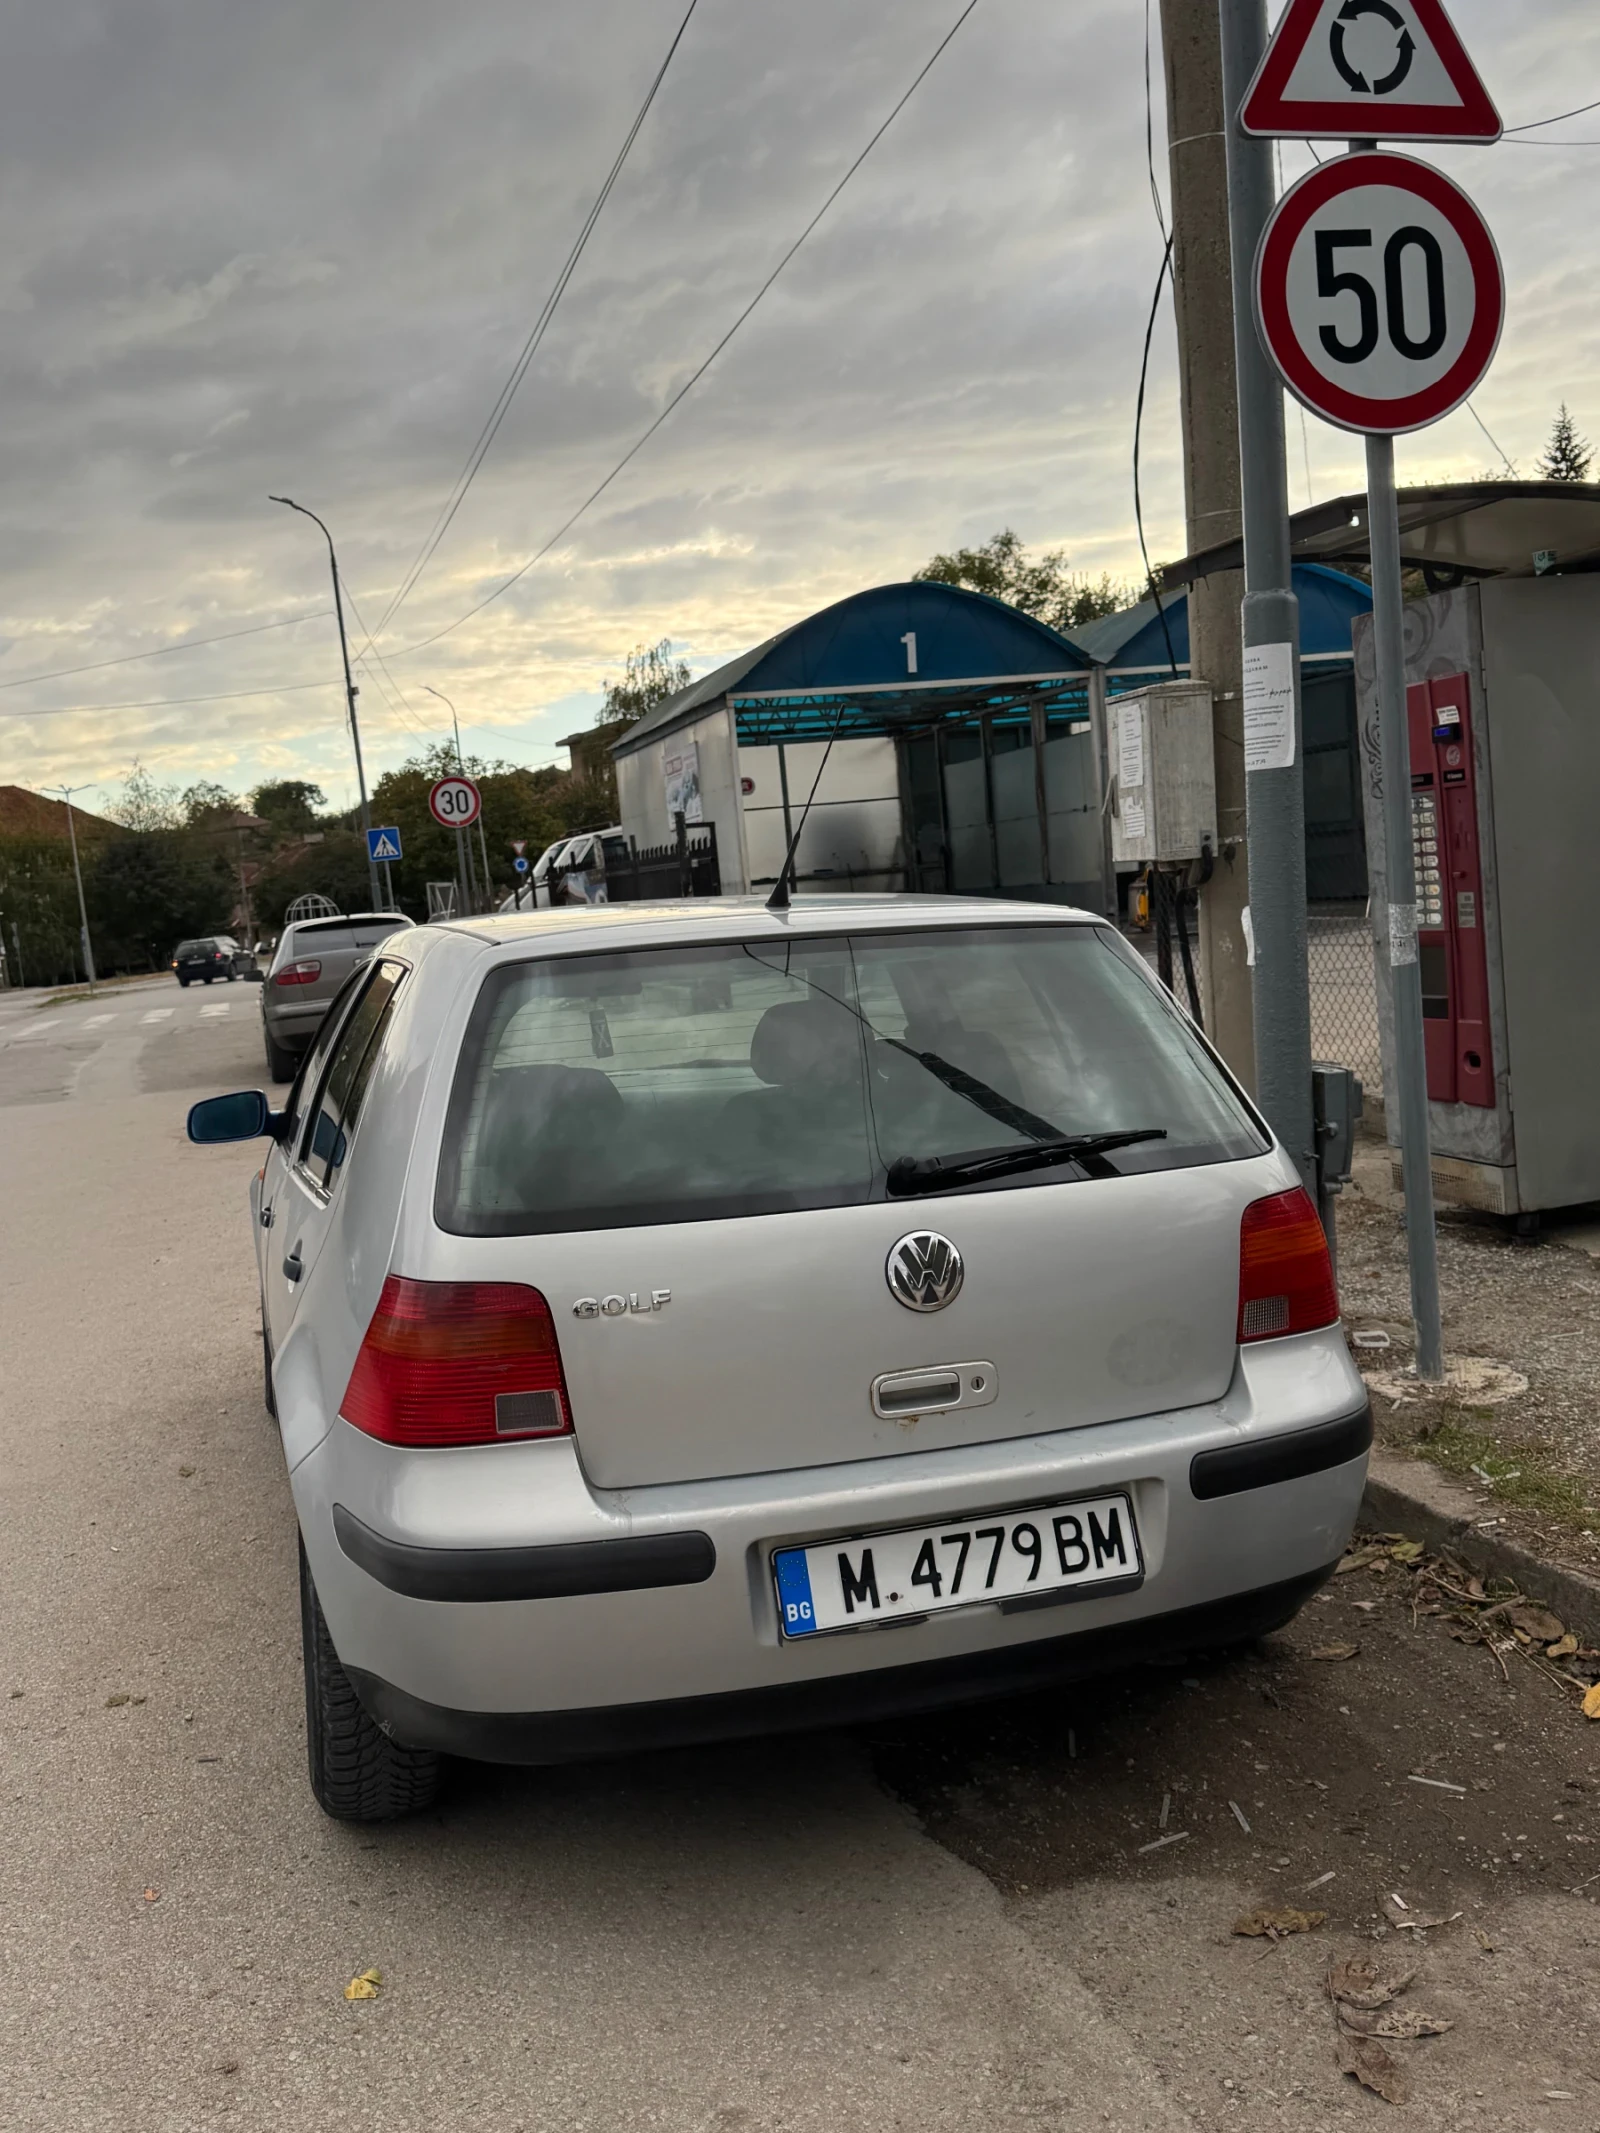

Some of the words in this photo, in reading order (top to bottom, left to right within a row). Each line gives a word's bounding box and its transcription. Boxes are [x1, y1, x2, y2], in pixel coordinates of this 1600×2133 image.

[1314, 225, 1447, 364] 50
[900, 631, 918, 673] 1
[441, 789, 470, 815] 30
[572, 1288, 672, 1320] GOLF
[786, 1601, 812, 1623] BG
